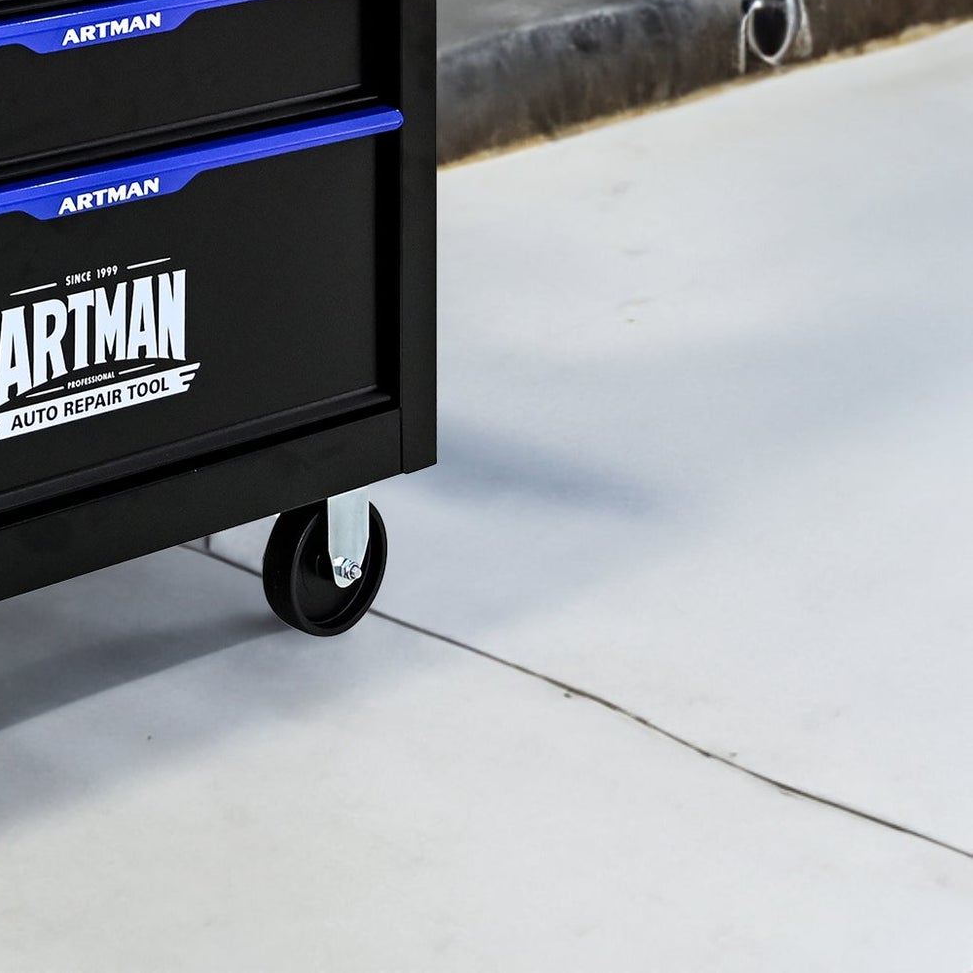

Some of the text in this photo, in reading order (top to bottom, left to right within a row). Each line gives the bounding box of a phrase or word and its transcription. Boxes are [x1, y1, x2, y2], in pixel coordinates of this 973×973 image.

[62, 12, 161, 46] ARTMAN
[58, 177, 159, 215] ARTMAN
[65, 265, 118, 286] SINCE 1999
[67, 370, 115, 390] PROFESSIONAL
[11, 377, 170, 431] AUTO REPAIR TOOL
